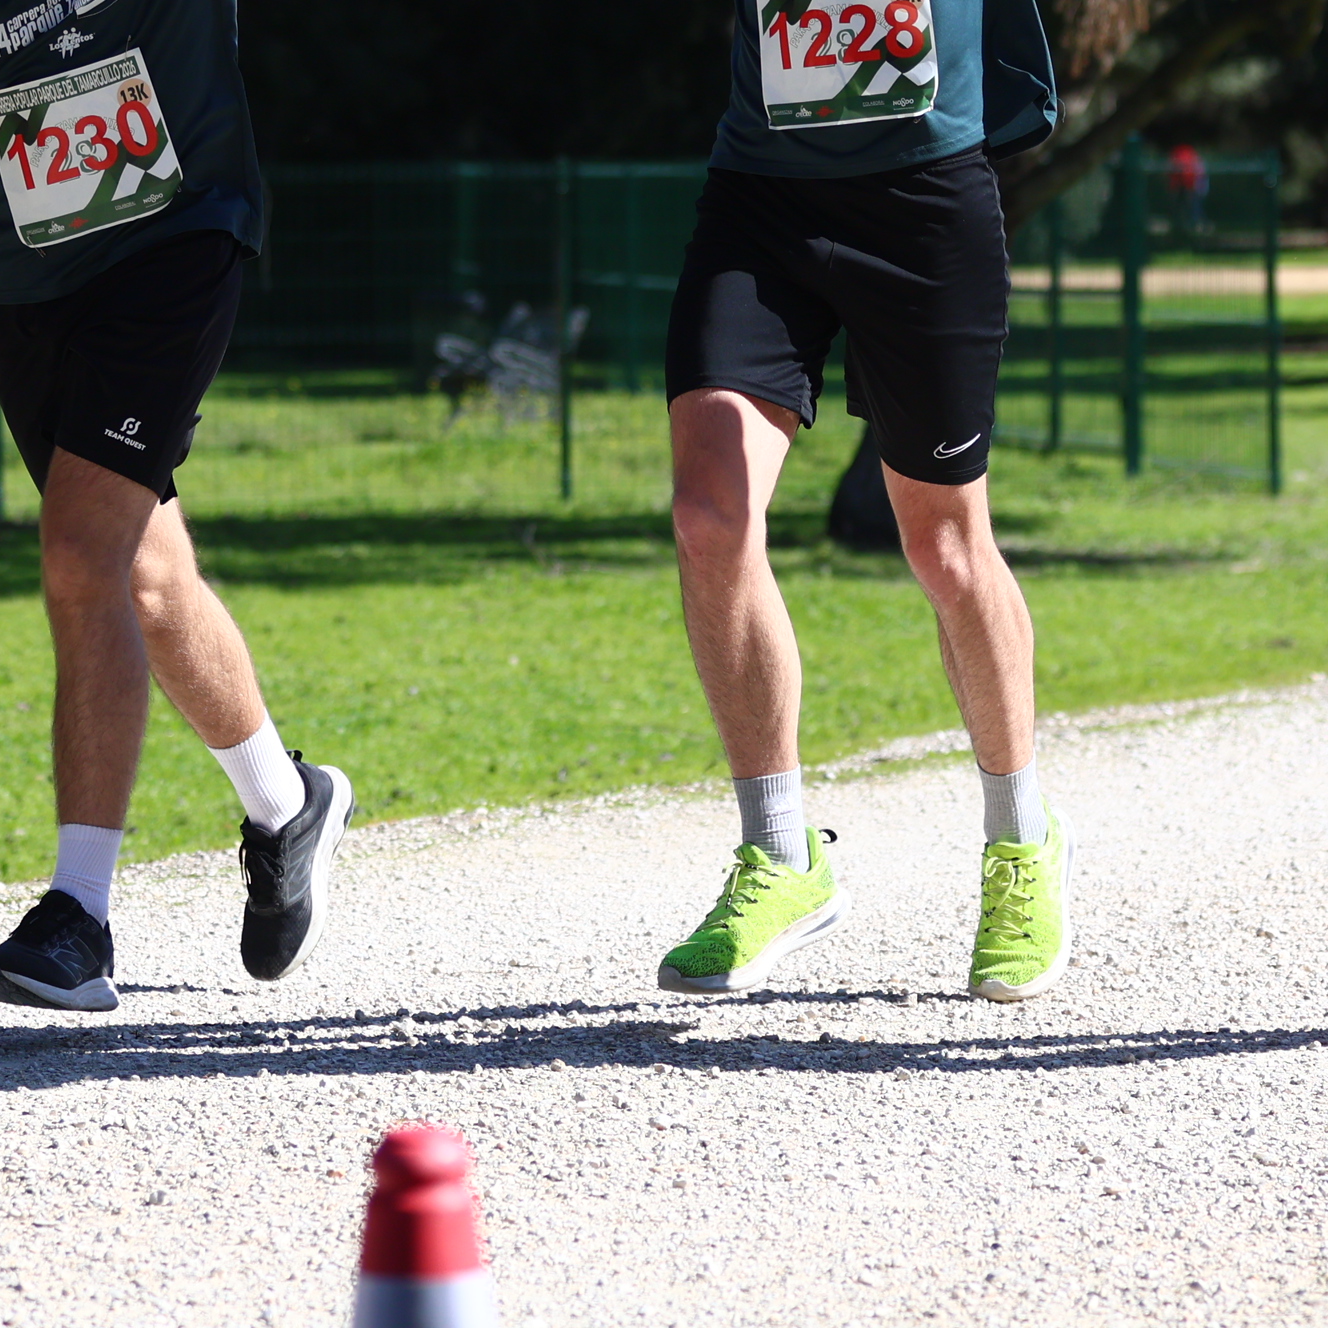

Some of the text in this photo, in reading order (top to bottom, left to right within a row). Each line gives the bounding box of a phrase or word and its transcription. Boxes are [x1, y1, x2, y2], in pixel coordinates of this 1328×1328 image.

[769, 0, 924, 69] 1228
[15, 87, 40, 110] POPULAR
[38, 82, 64, 104] PARQUE
[62, 79, 77, 96] DEL
[74, 63, 120, 92] TAMARGUILLO
[120, 83, 149, 103] 13K
[7, 100, 159, 190] 1230
[104, 428, 147, 451] TEAM QUEST
